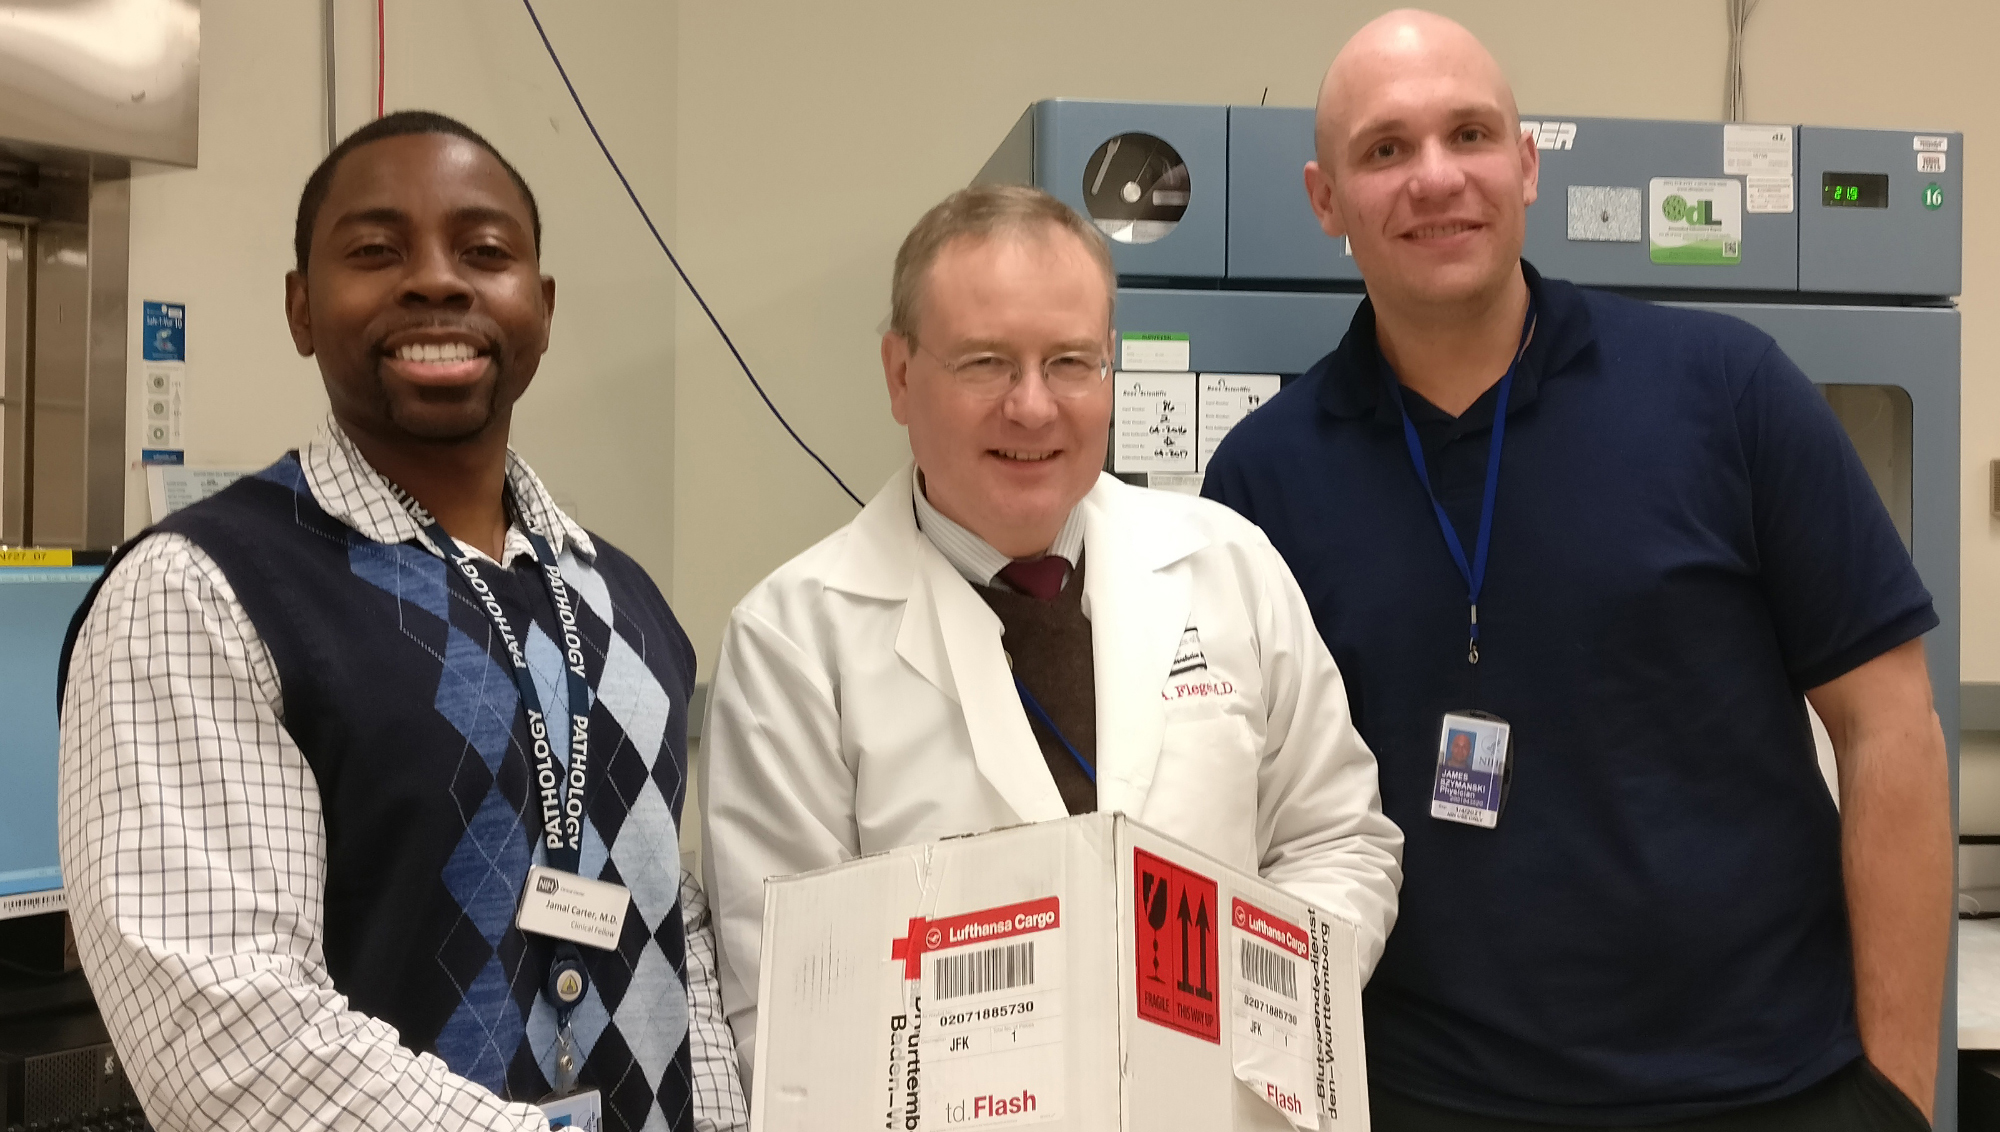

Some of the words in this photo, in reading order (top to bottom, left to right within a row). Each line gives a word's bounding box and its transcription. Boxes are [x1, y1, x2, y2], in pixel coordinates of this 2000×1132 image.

[1925, 189, 1942, 206] 16
[452, 553, 527, 668] PATHOLOGY
[544, 564, 586, 679] PATHOLOGY
[528, 708, 564, 850] PATHOLOGY
[566, 714, 589, 851] PATHOLOGY
[1440, 779, 1485, 794] SZYMANSKI
[1442, 769, 1468, 780] JAMES
[1440, 785, 1475, 798] Physician
[538, 879, 554, 892] NIH
[546, 899, 570, 914] Jamal
[571, 905, 597, 920] Carter,
[599, 914, 618, 926] M.D.
[570, 920, 594, 932] Clinical
[594, 926, 616, 938] Fellow
[949, 919, 1012, 942] Lufthansa
[1014, 911, 1055, 928] Cargo
[1248, 914, 1286, 944] Lufthansa
[1286, 932, 1307, 955] Cargo
[1144, 990, 1169, 1013] FRAGILE
[1244, 995, 1297, 1026] 02071885730
[940, 1001, 1034, 1027] 02071885730
[1177, 1003, 1190, 1020] THIS
[1190, 1007, 1204, 1026] WAY
[1204, 1013, 1214, 1028] UP
[1011, 1030, 1016, 1043] 1
[1250, 1020, 1262, 1037] JFK
[949, 1036, 969, 1052] JFK
